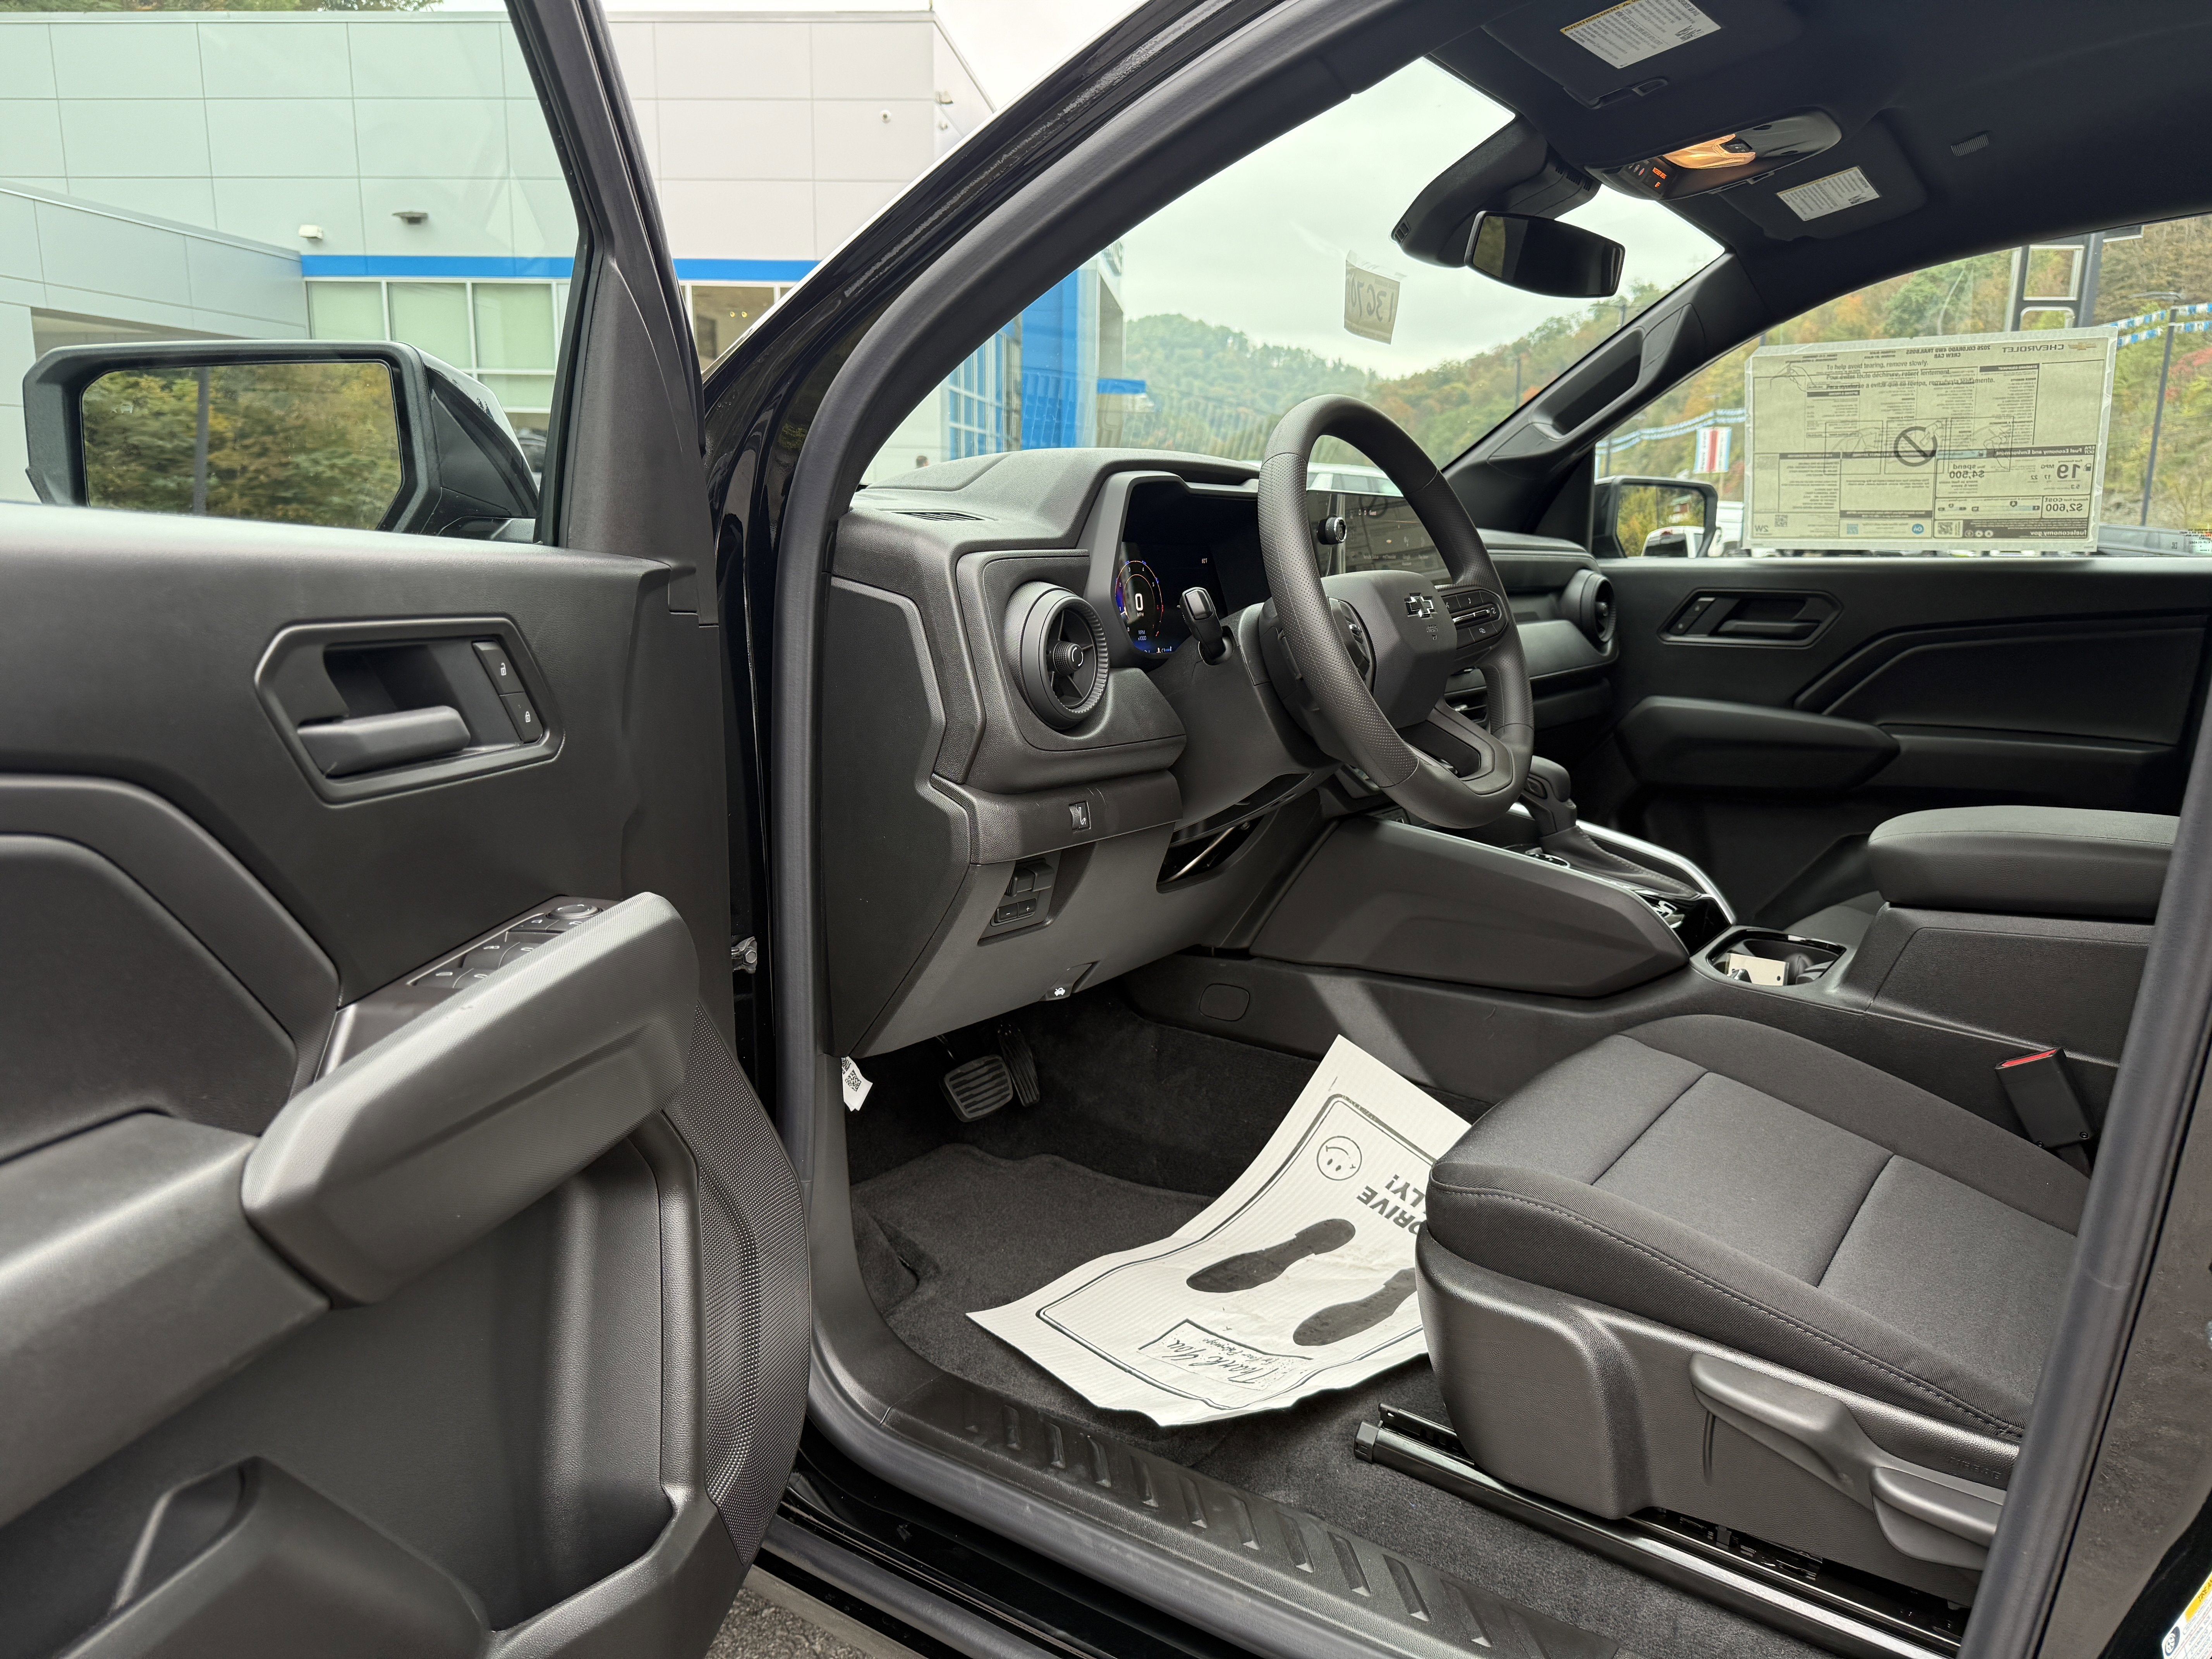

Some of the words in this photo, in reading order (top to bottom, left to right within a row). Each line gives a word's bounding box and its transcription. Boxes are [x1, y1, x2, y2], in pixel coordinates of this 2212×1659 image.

[1135, 593, 1143, 611] 0
[1385, 1174, 1426, 1214] LY!
[1161, 1340, 1206, 1361] You
[1188, 1355, 1279, 1384] Thank
